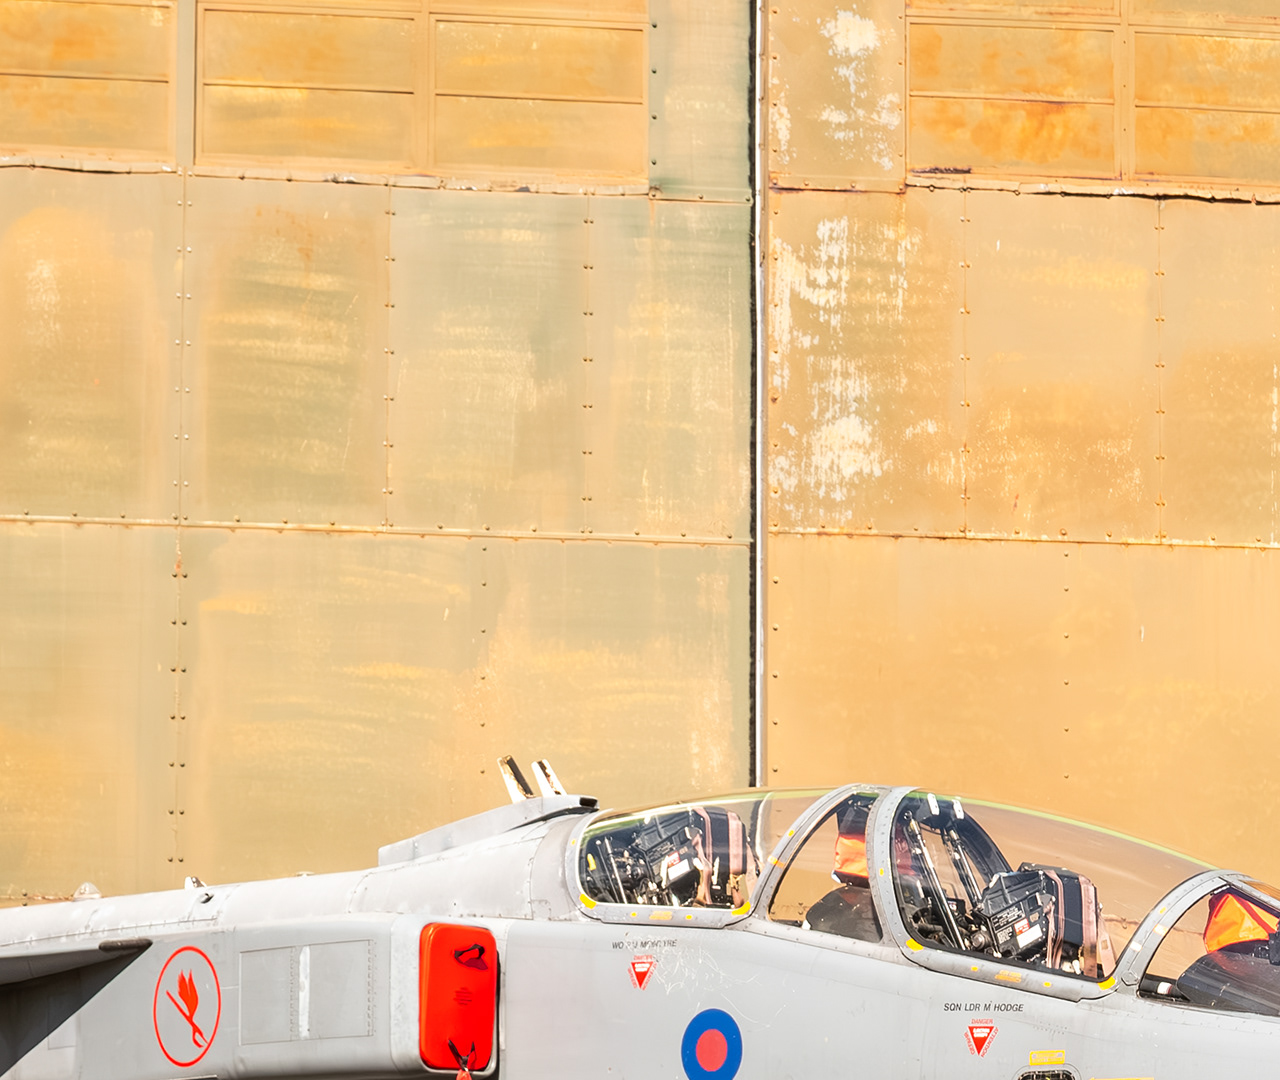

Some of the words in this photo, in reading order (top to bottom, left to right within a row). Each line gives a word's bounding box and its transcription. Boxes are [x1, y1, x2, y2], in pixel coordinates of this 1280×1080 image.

[943, 1002, 962, 1012] SQN
[964, 1002, 981, 1012] LDR
[983, 1002, 992, 1012] M
[993, 1003, 1025, 1012] HODGE
